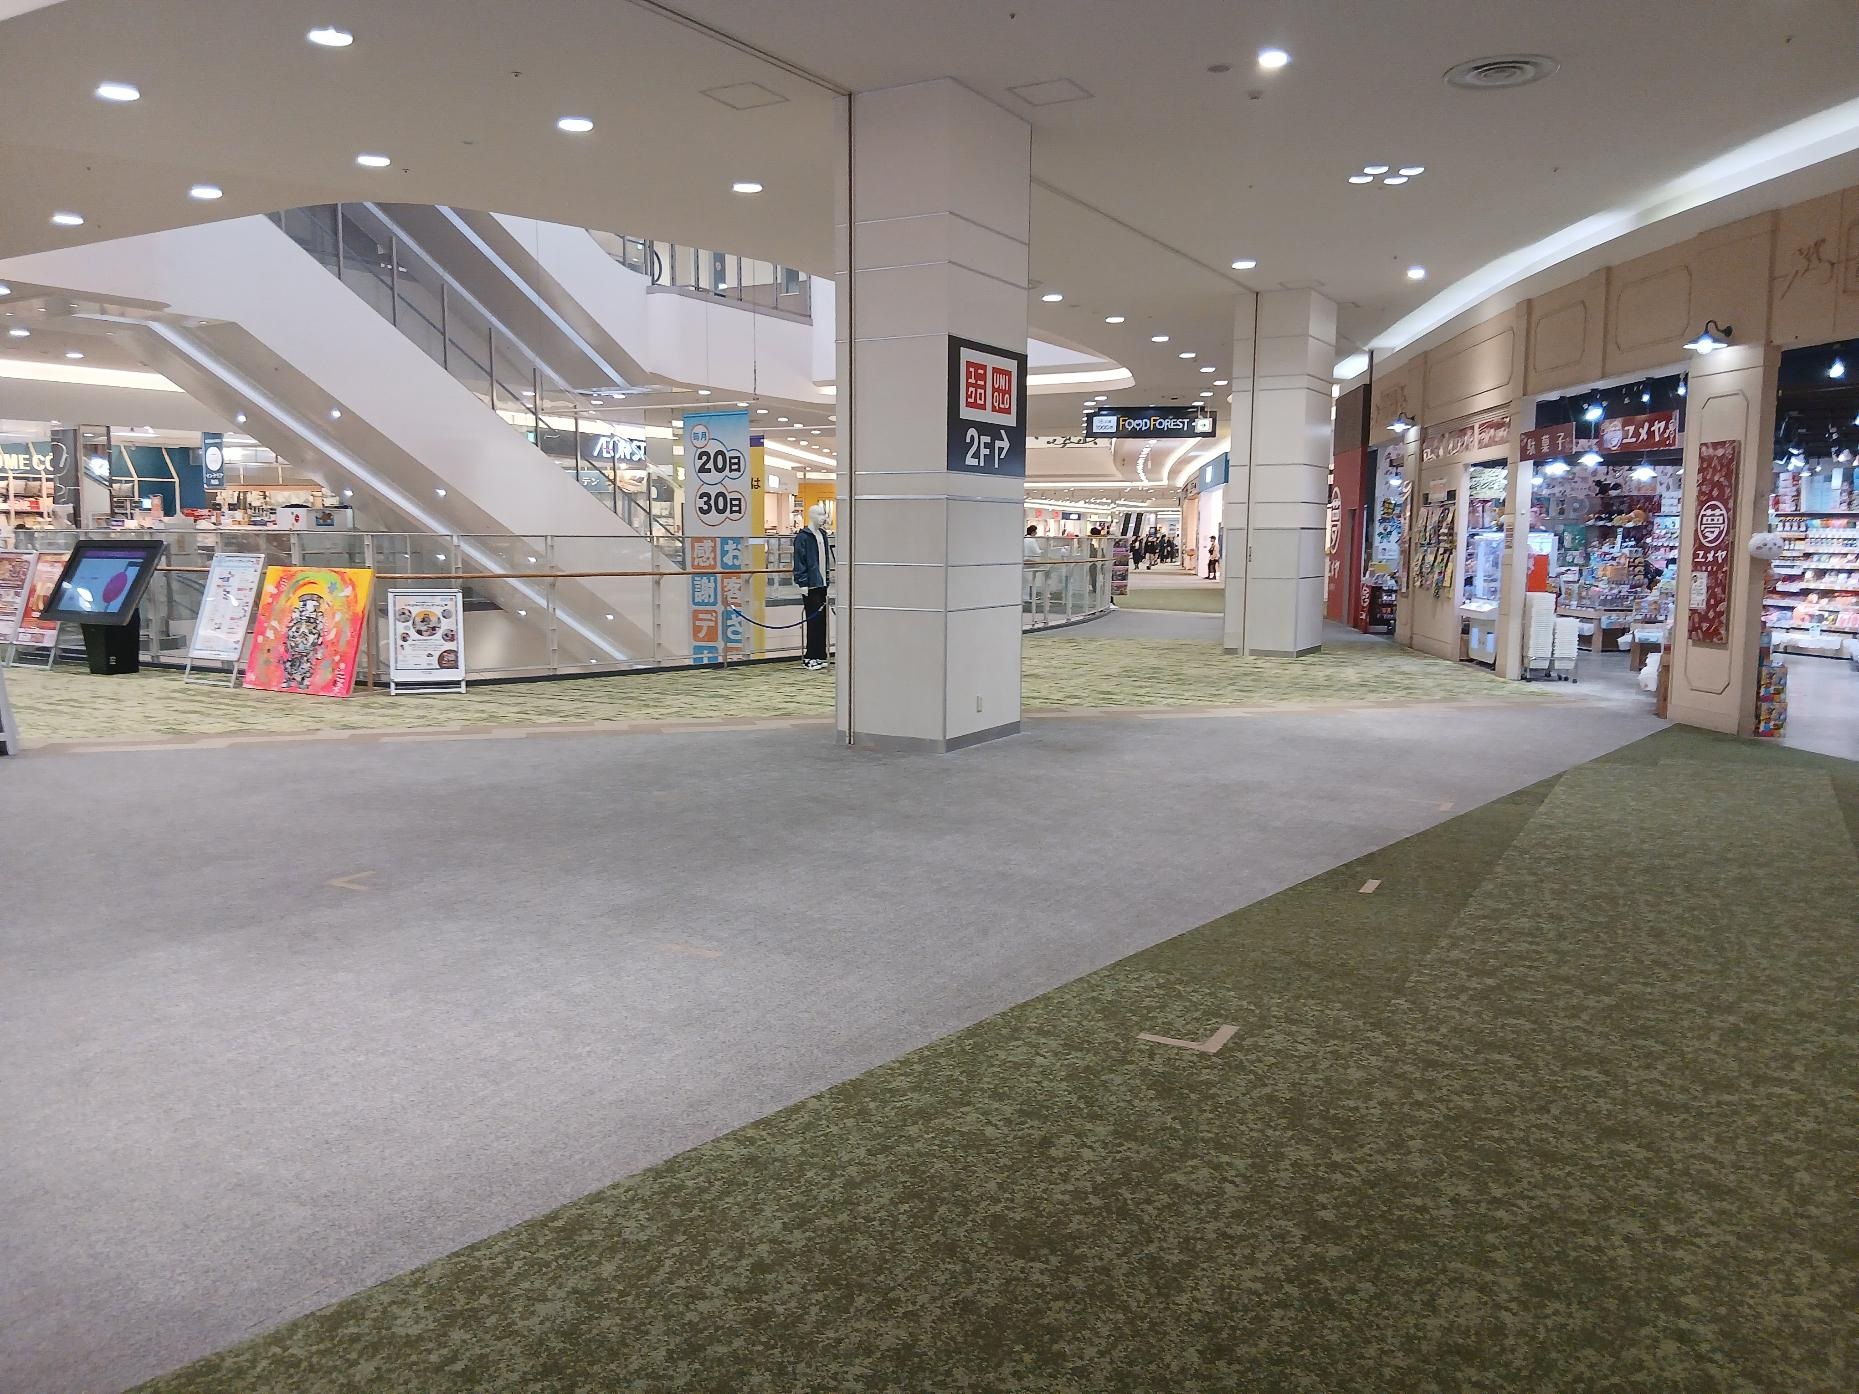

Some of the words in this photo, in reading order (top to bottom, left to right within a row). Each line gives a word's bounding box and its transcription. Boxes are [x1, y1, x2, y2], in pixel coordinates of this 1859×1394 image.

[993, 372, 1009, 391] UNI
[993, 391, 1010, 410] QLO
[1622, 419, 1665, 444] ユメヤ
[965, 427, 991, 467] 2F
[697, 449, 741, 474] 20日
[698, 491, 742, 515] 30日
[1694, 550, 1728, 564] ユメヤ
